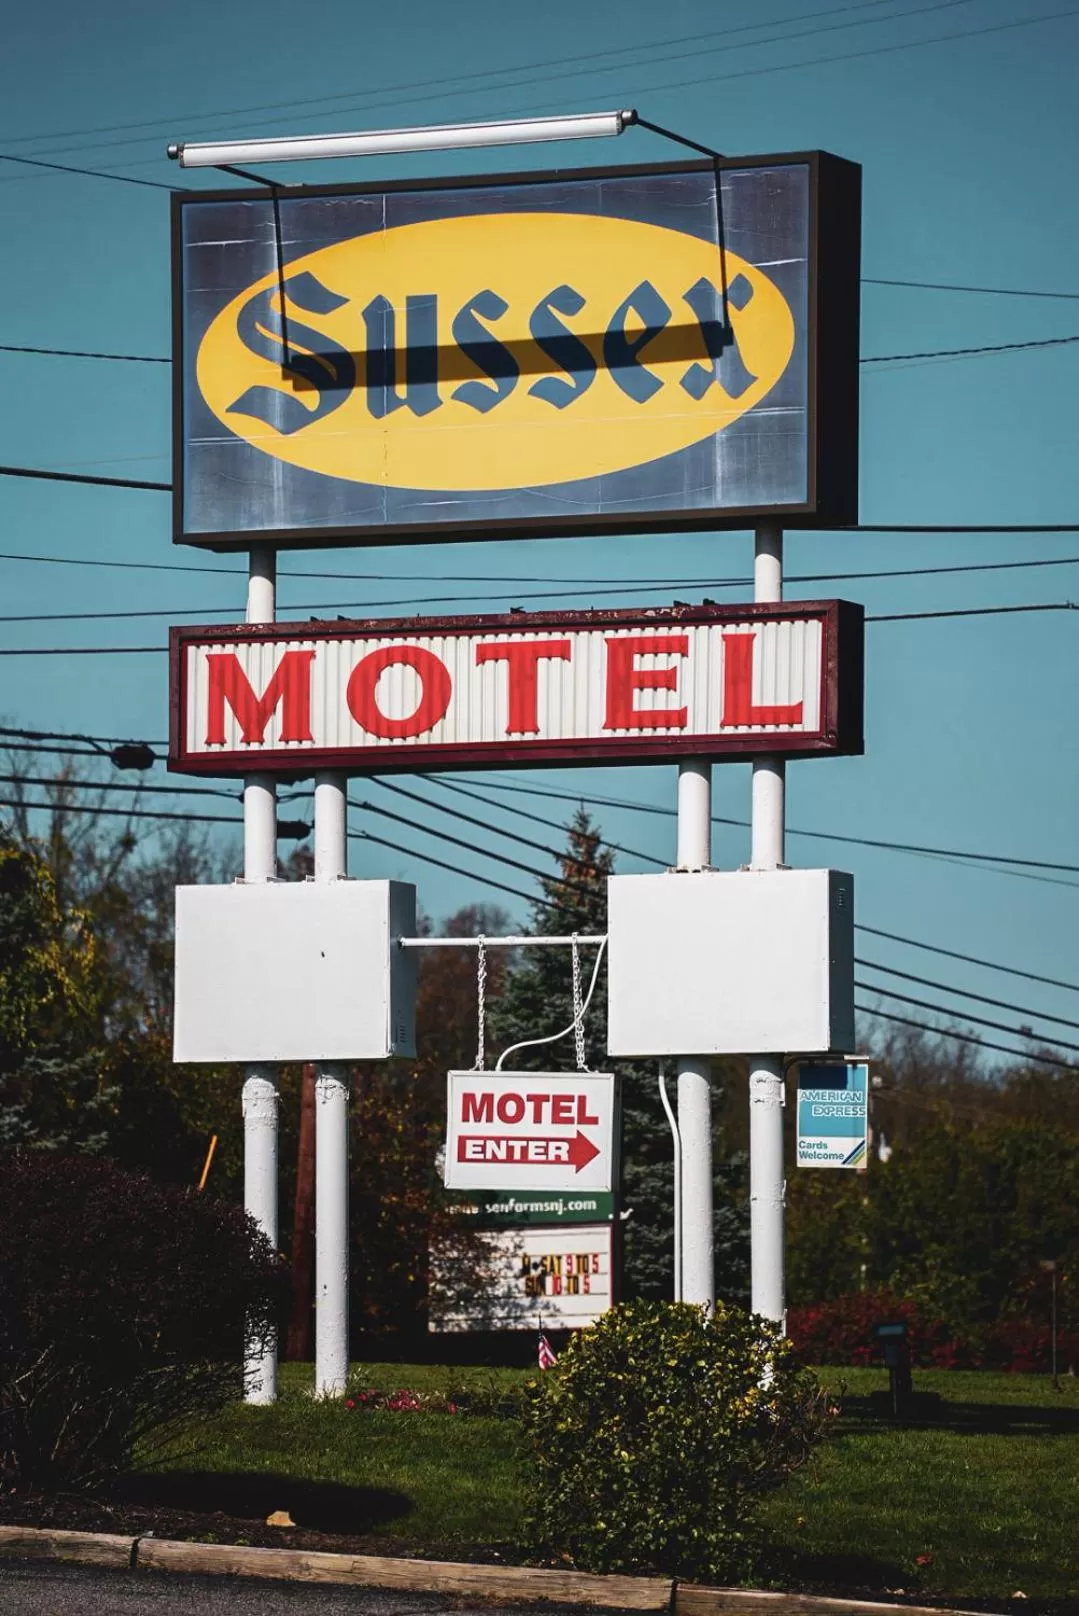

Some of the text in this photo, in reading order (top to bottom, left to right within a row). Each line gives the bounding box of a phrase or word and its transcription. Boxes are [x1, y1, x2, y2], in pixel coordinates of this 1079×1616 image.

[225, 271, 759, 436] Sussex
[204, 632, 803, 745] MOTEL
[799, 1090, 864, 1103] AMERICAN
[461, 1092, 600, 1126] MOTEL
[812, 1104, 866, 1118] EXPRESS
[464, 1139, 570, 1162] ENTER
[799, 1140, 829, 1150] Cards
[799, 1151, 845, 1161] Welcome
[592, 1253, 600, 1274] 5
